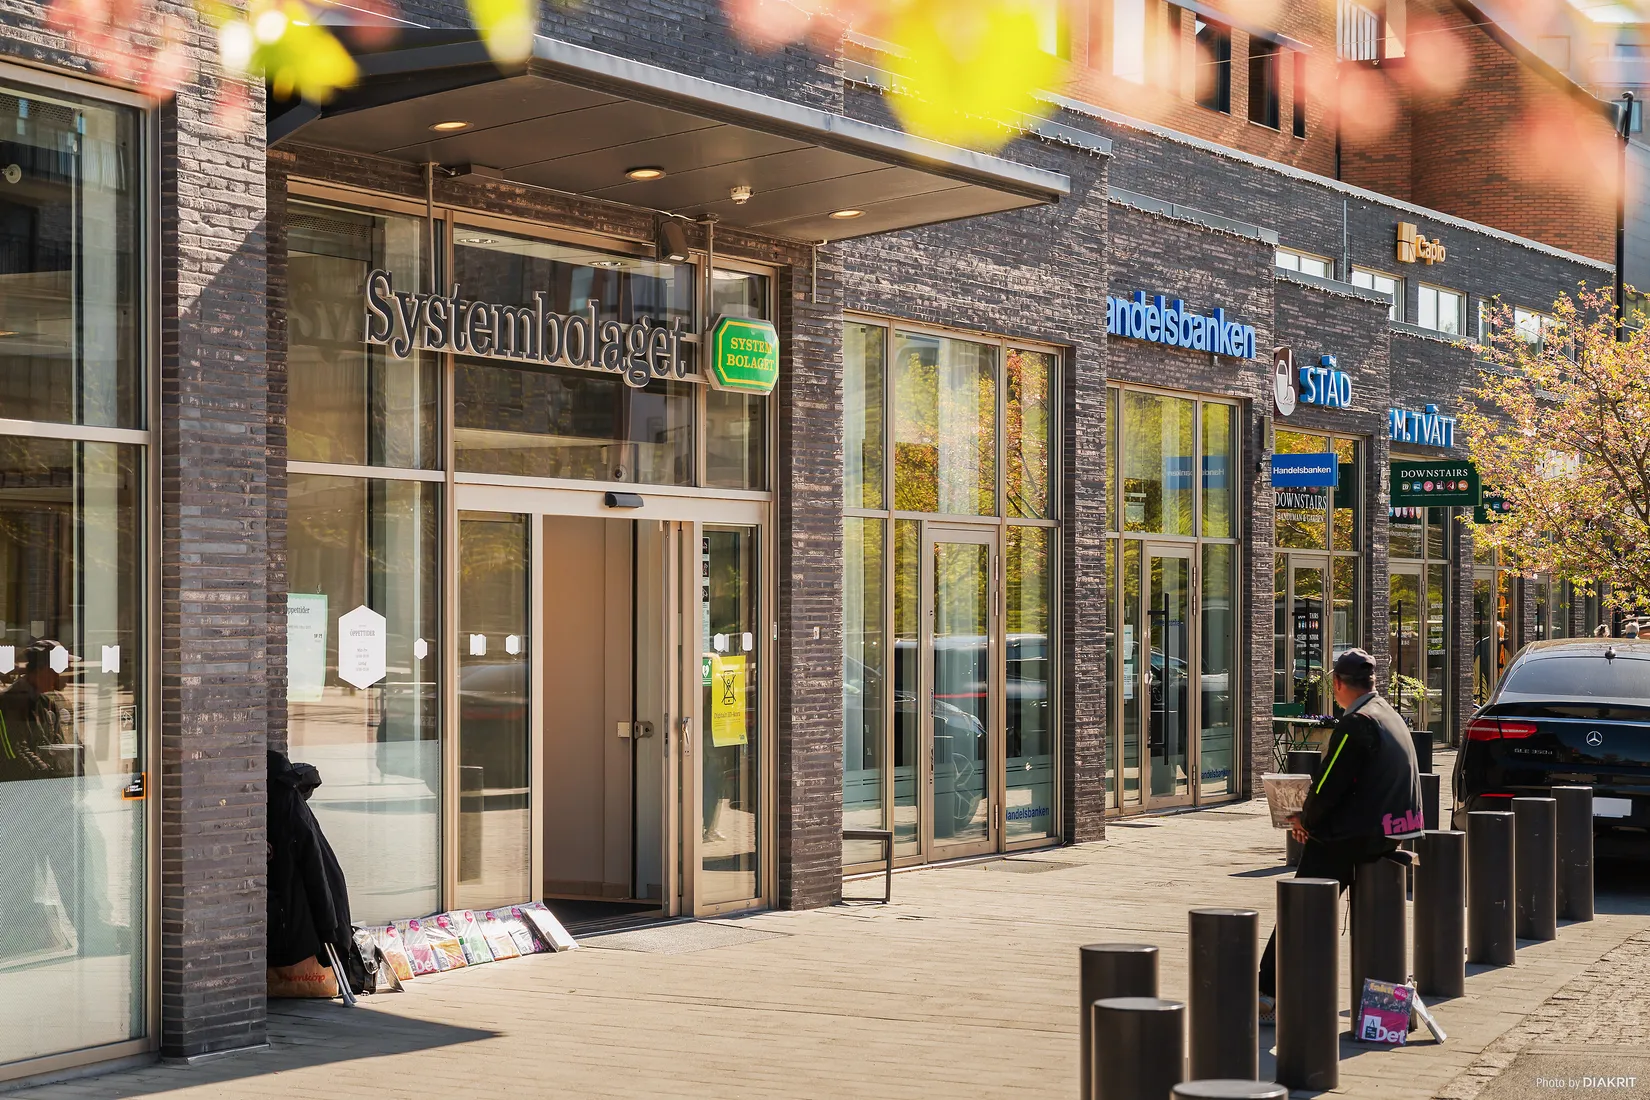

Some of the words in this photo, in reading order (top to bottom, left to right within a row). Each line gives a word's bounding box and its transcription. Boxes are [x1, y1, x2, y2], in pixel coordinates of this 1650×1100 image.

[1417, 235, 1446, 265] Capio
[365, 269, 687, 387] Systembolaget
[731, 337, 772, 354] SYSTEM
[726, 354, 774, 371] BOLAGET
[1273, 466, 1332, 475] Handelsbanken
[1401, 468, 1469, 478] DOWNSTAIRS
[1275, 491, 1327, 509] DOWNSTAIRS
[1006, 805, 1049, 821] andelsbanken
